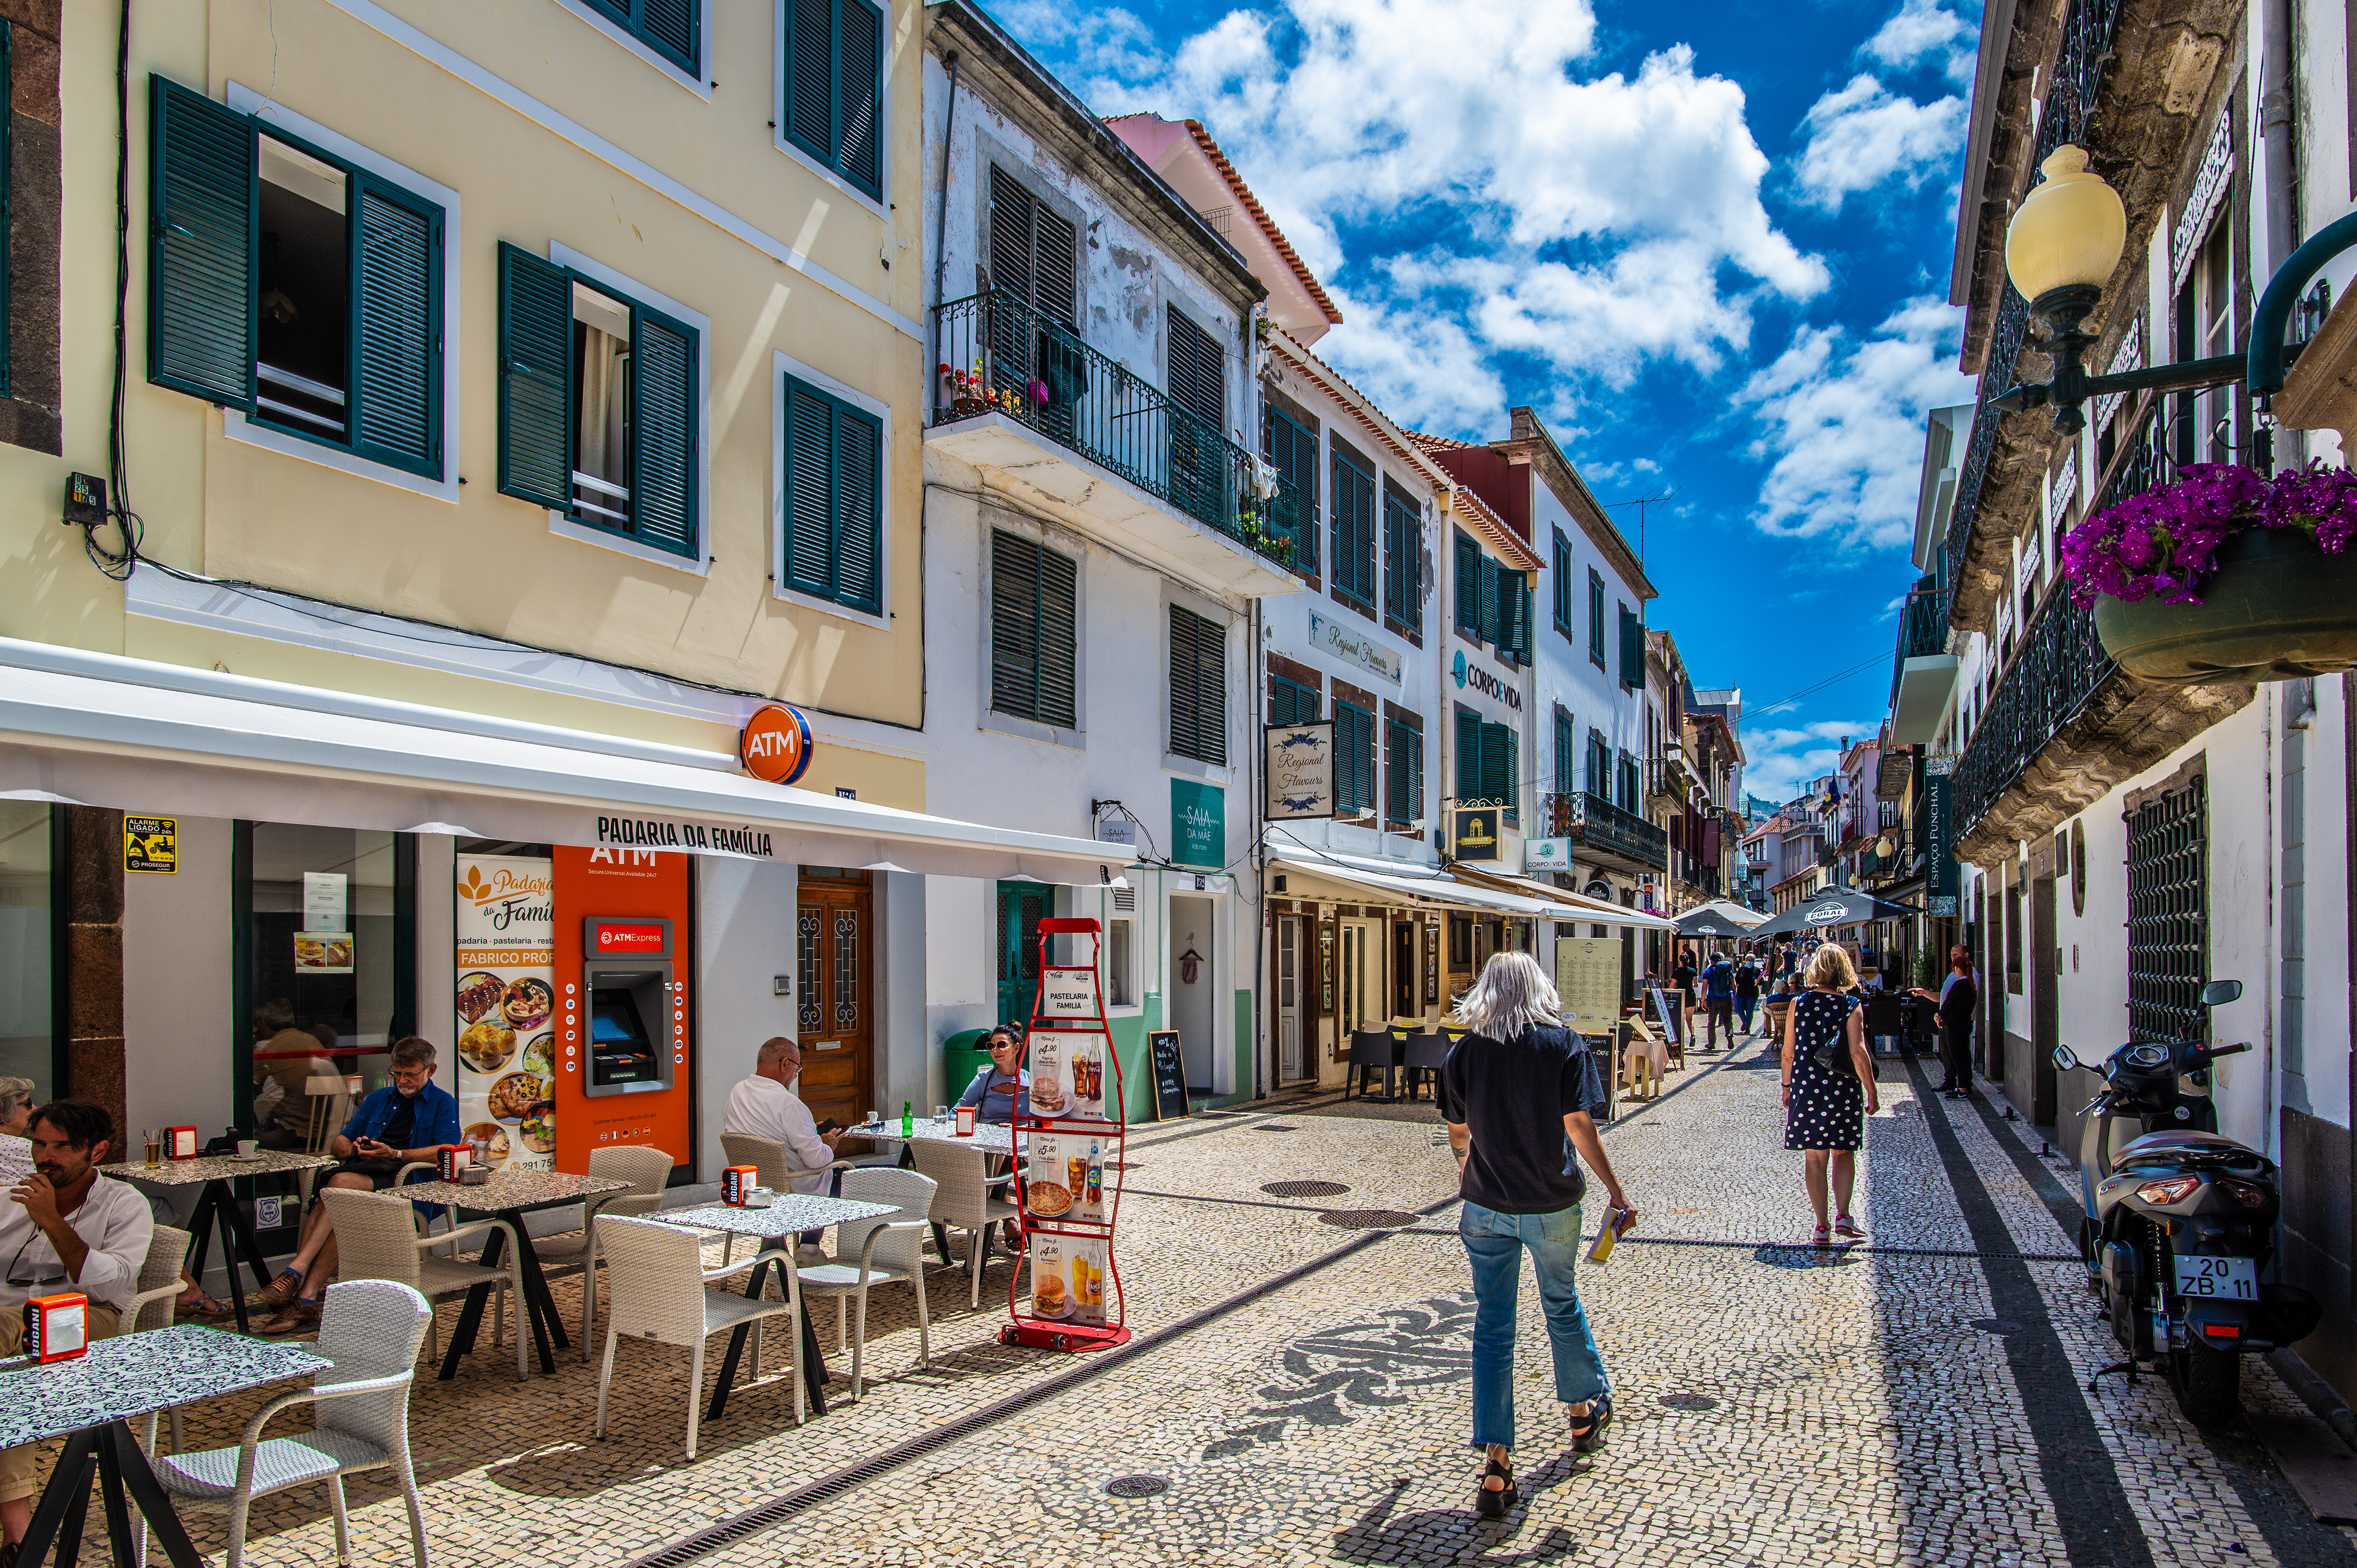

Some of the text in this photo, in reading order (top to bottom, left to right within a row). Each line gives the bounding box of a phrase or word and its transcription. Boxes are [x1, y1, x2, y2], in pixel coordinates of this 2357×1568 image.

[75, 484, 88, 494] 25
[1329, 626, 1387, 670] Regional Flavours
[1468, 664, 1499, 699] CORPO
[1503, 683, 1522, 712] VIDA
[748, 729, 793, 758] ATM
[1277, 753, 1325, 772] Regional
[1277, 773, 1324, 789] Flavours
[1187, 805, 1211, 828] SAIA
[598, 816, 773, 857] PADARIA DA FAMÍLIA
[1108, 829, 1125, 837] SAIA
[1187, 828, 1211, 841] DA MÃE
[1930, 782, 1941, 888] ESPAÇO FUNCHAL
[493, 869, 553, 896] Padaria
[1196, 876, 1204, 888] 152
[483, 906, 495, 916] da
[1811, 910, 1843, 919] CORAL
[614, 934, 660, 942] ATMExpress
[461, 952, 519, 964] FABRICO
[1158, 1037, 1169, 1047] 100%
[1585, 1035, 1606, 1044] Flavours
[1038, 1044, 1057, 1055] €4.90
[1158, 1060, 1176, 1072] Portugal
[1038, 1145, 1056, 1155] €5.90
[522, 1161, 538, 1170] 291
[1040, 1246, 1058, 1256] €4.90
[2200, 1258, 2229, 1278] 20
[2180, 1276, 2252, 1298] ZB 11
